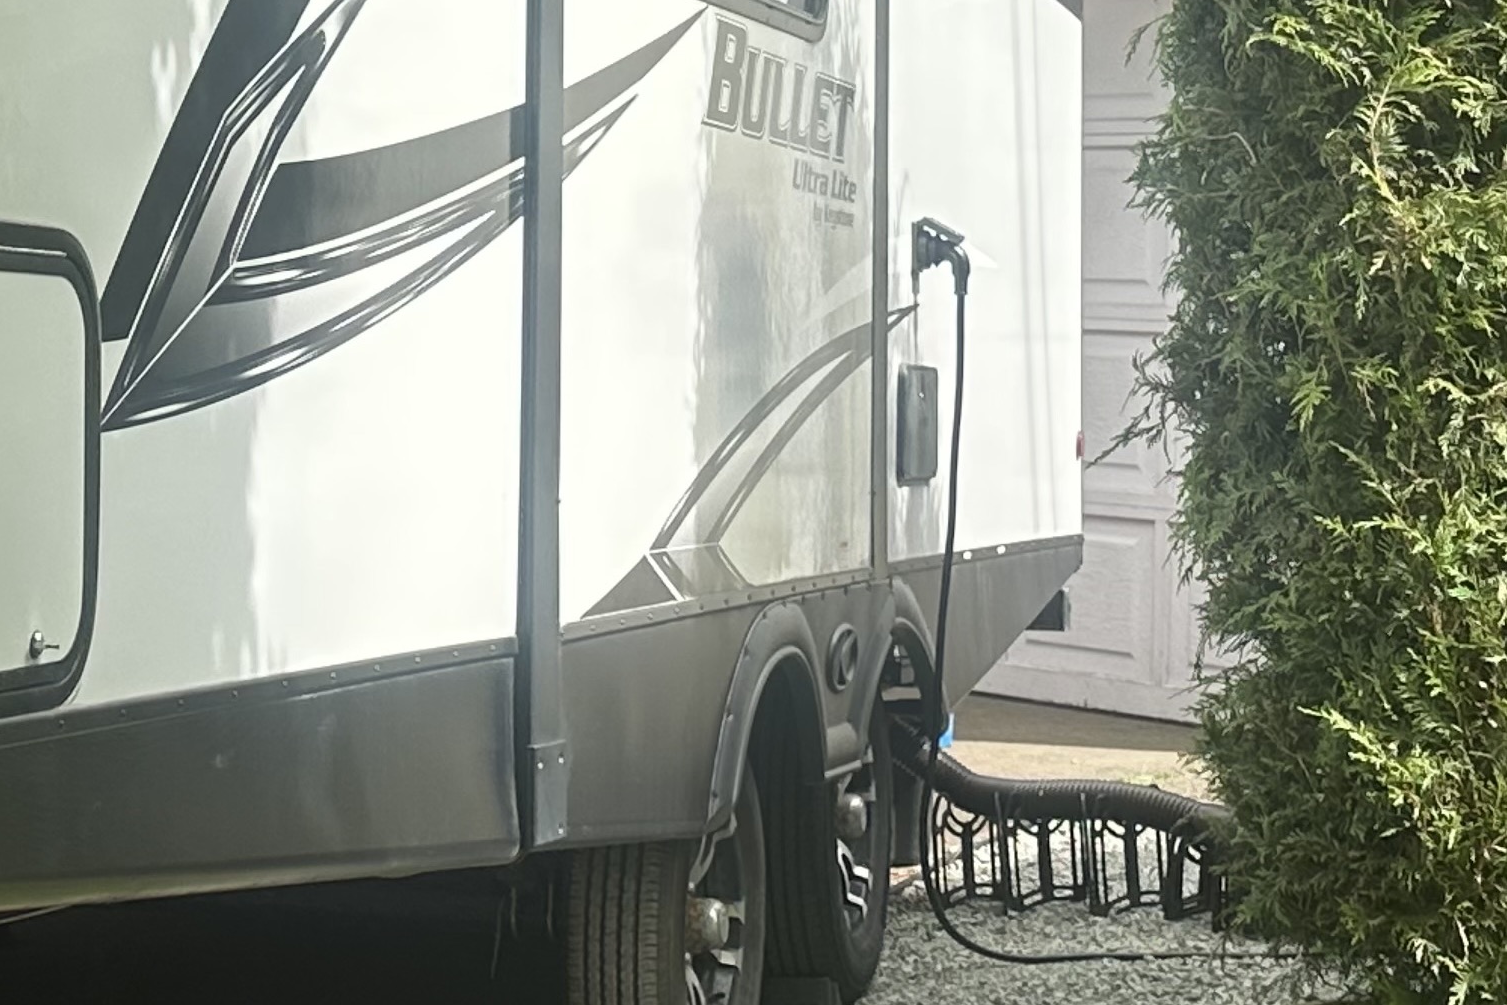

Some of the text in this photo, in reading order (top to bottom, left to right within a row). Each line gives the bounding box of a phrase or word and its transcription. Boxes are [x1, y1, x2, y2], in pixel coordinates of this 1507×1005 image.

[701, 13, 856, 163] BULLET
[793, 158, 857, 203] Ultra Lite
